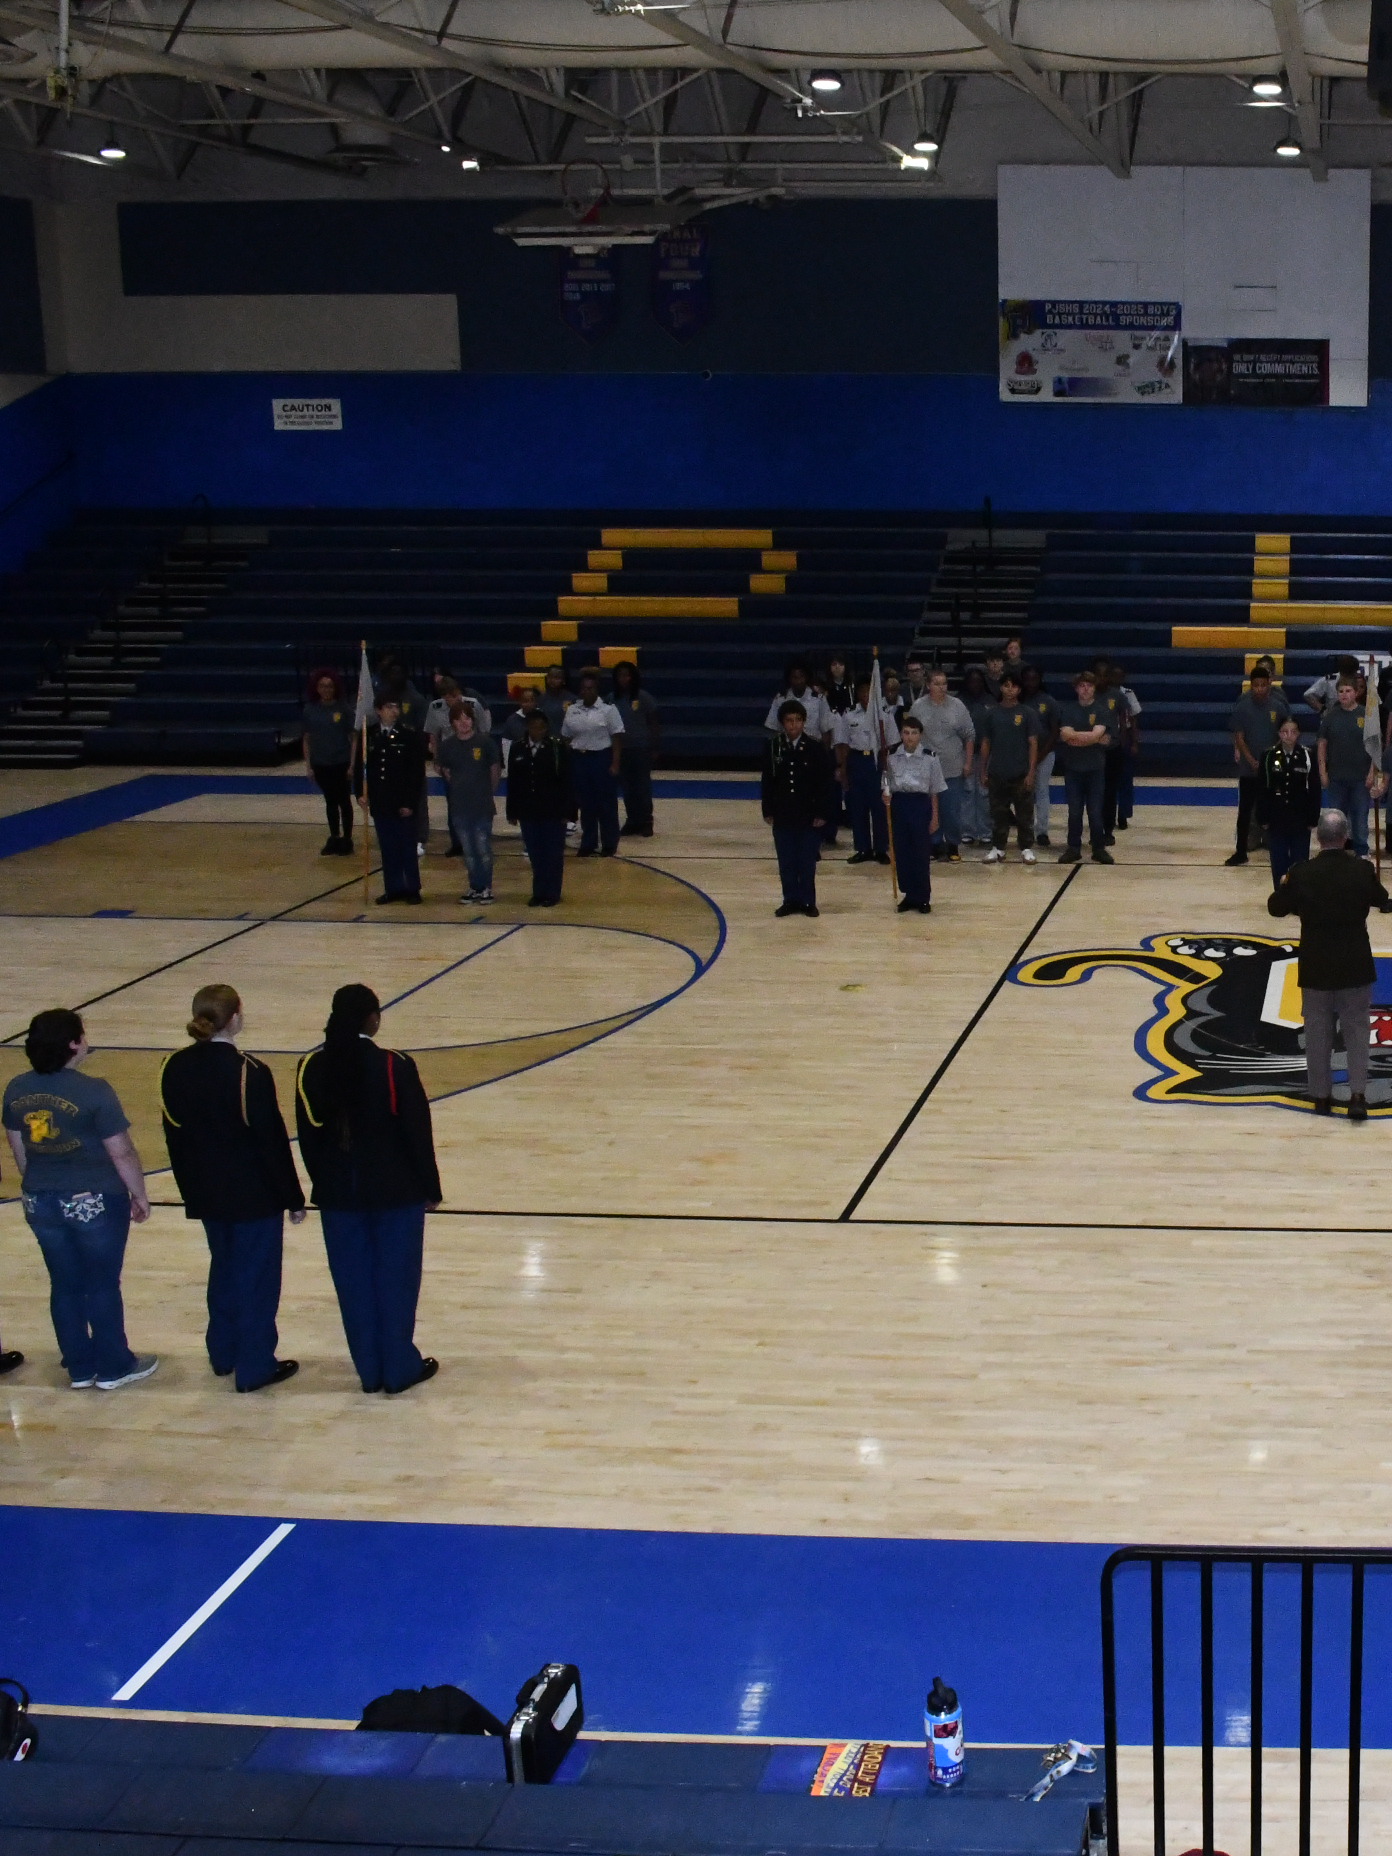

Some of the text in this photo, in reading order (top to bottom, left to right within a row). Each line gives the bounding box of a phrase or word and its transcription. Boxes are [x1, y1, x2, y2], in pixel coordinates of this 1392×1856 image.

[1083, 303, 1144, 315] 2024-2025
[1147, 304, 1176, 316] BOYS
[1046, 314, 1175, 326] BASKETBALL SPONSORS
[1232, 362, 1320, 375] ONLY COMMITMENTS.
[282, 403, 332, 413] CAUTION
